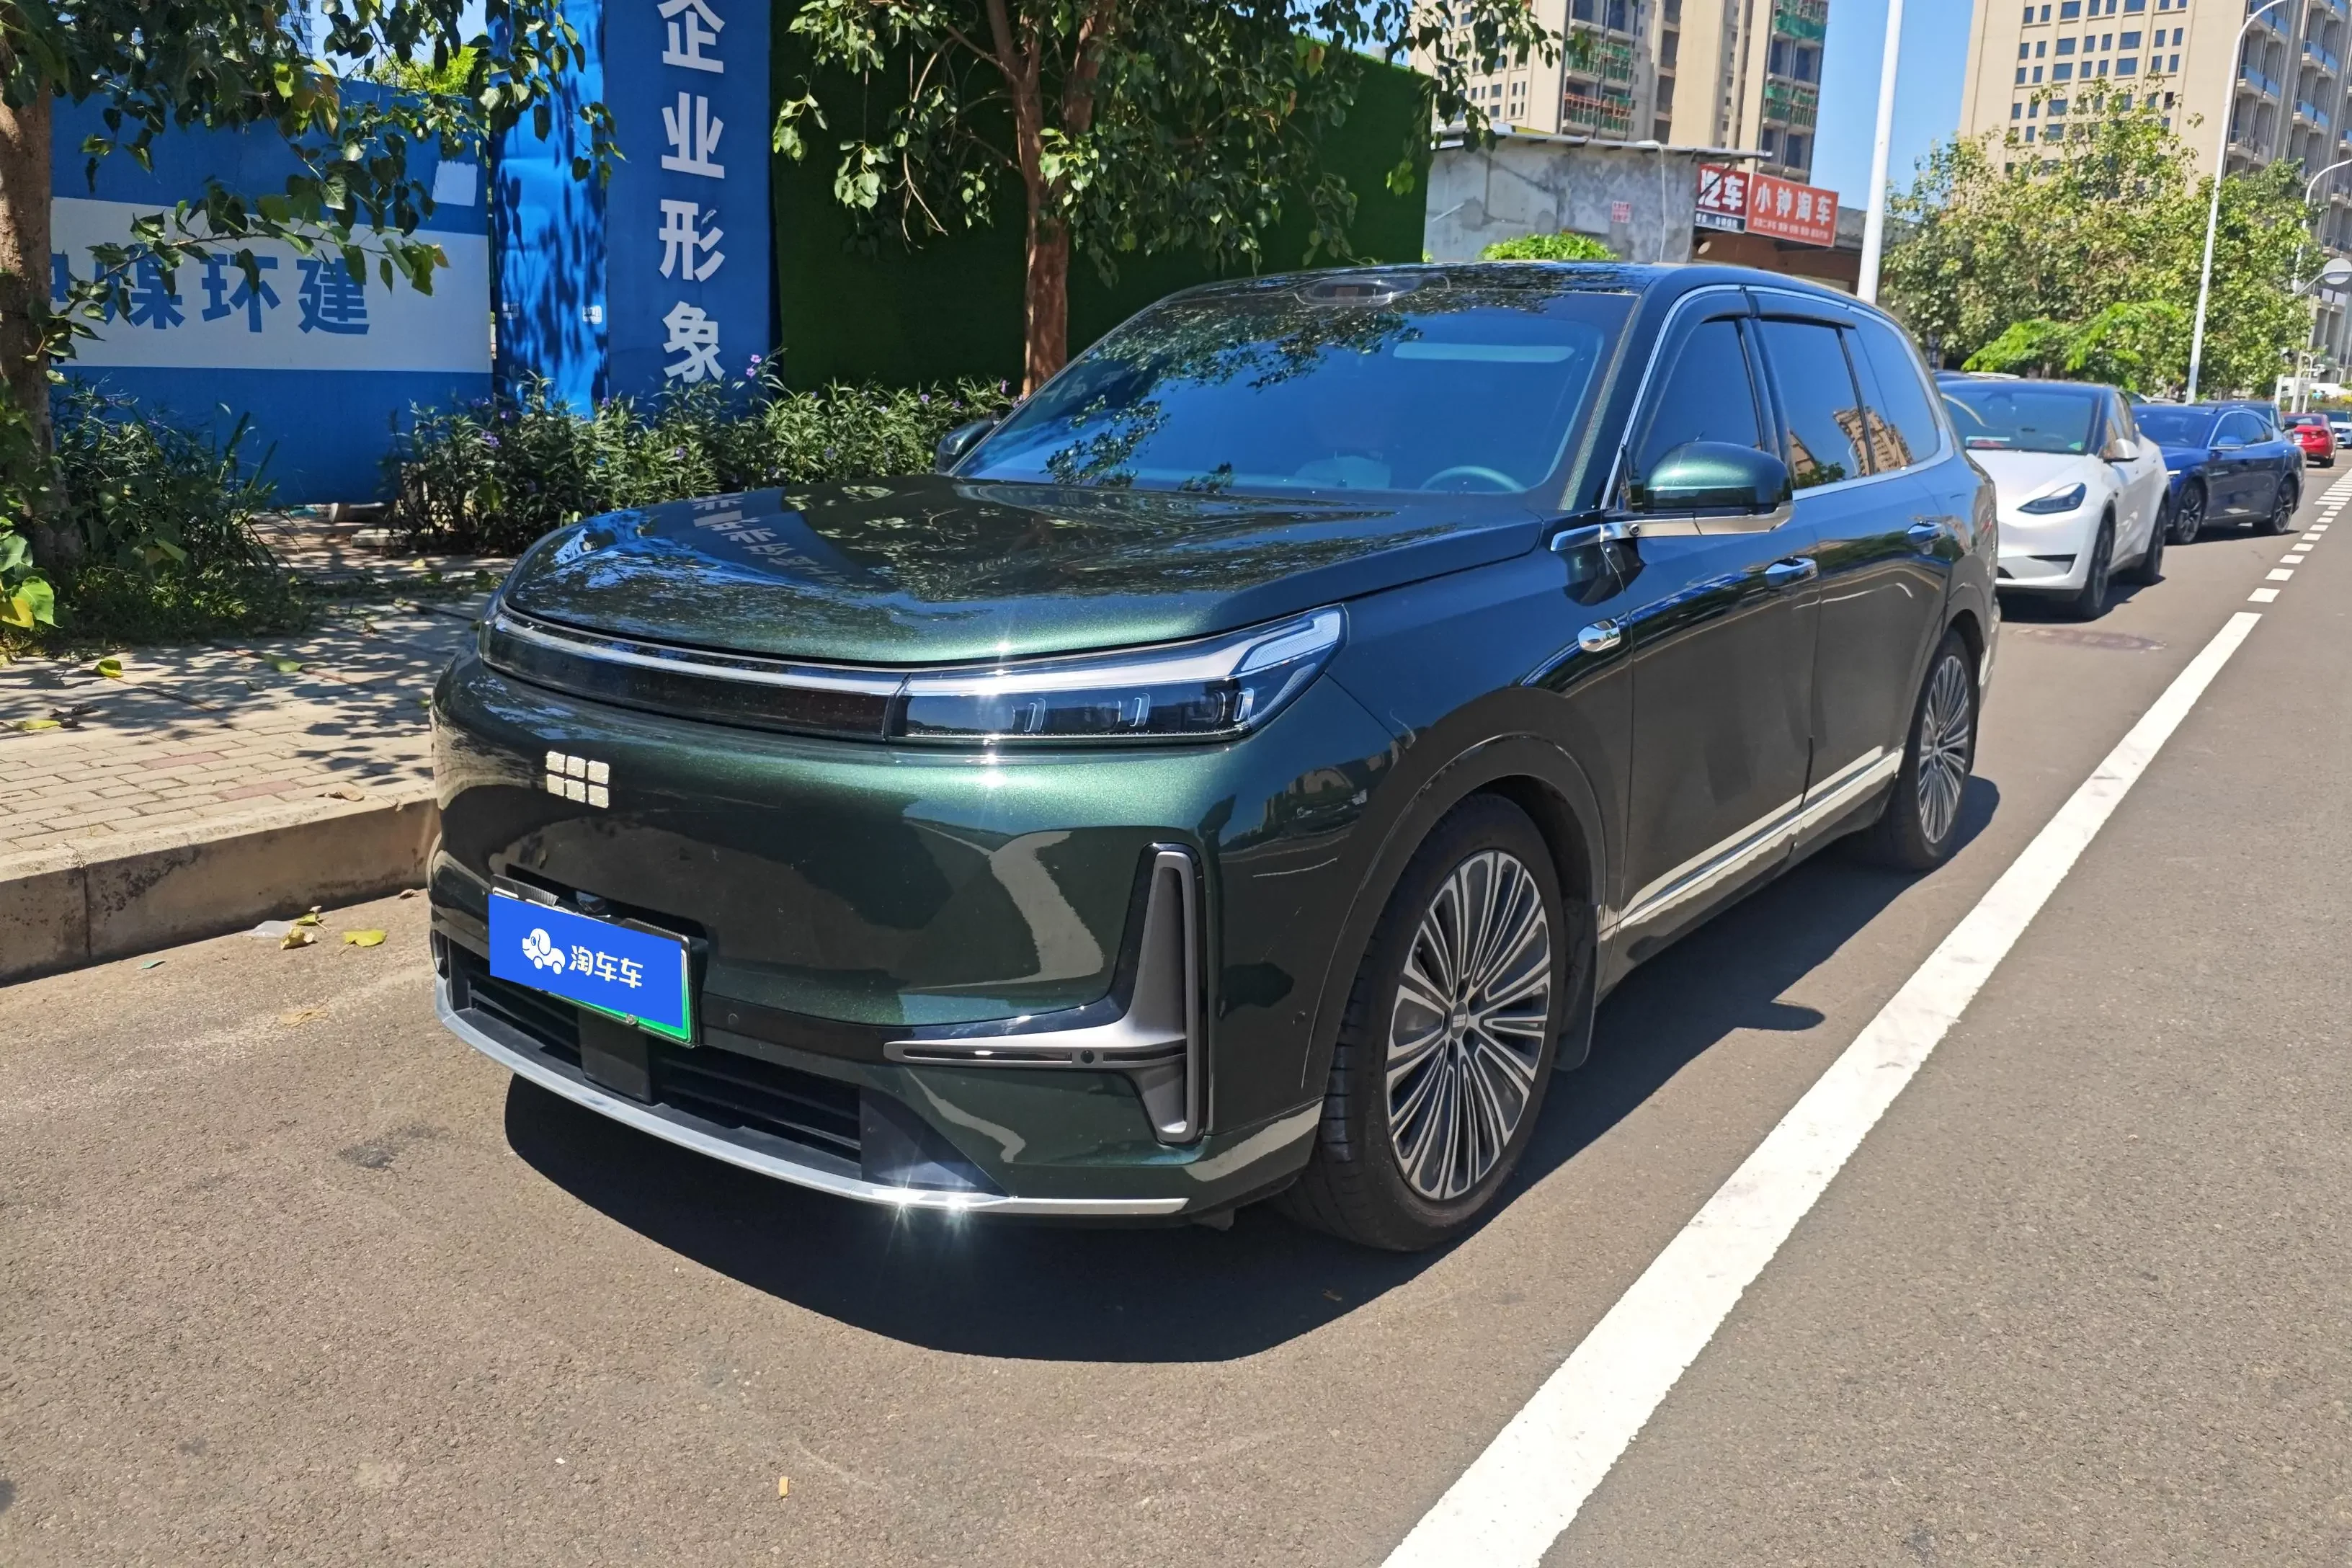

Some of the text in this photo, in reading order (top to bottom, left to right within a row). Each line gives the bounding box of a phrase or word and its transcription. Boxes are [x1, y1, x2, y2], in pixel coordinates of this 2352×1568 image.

[656, 0, 726, 383] 企业形象
[1698, 169, 1745, 210] 汽车
